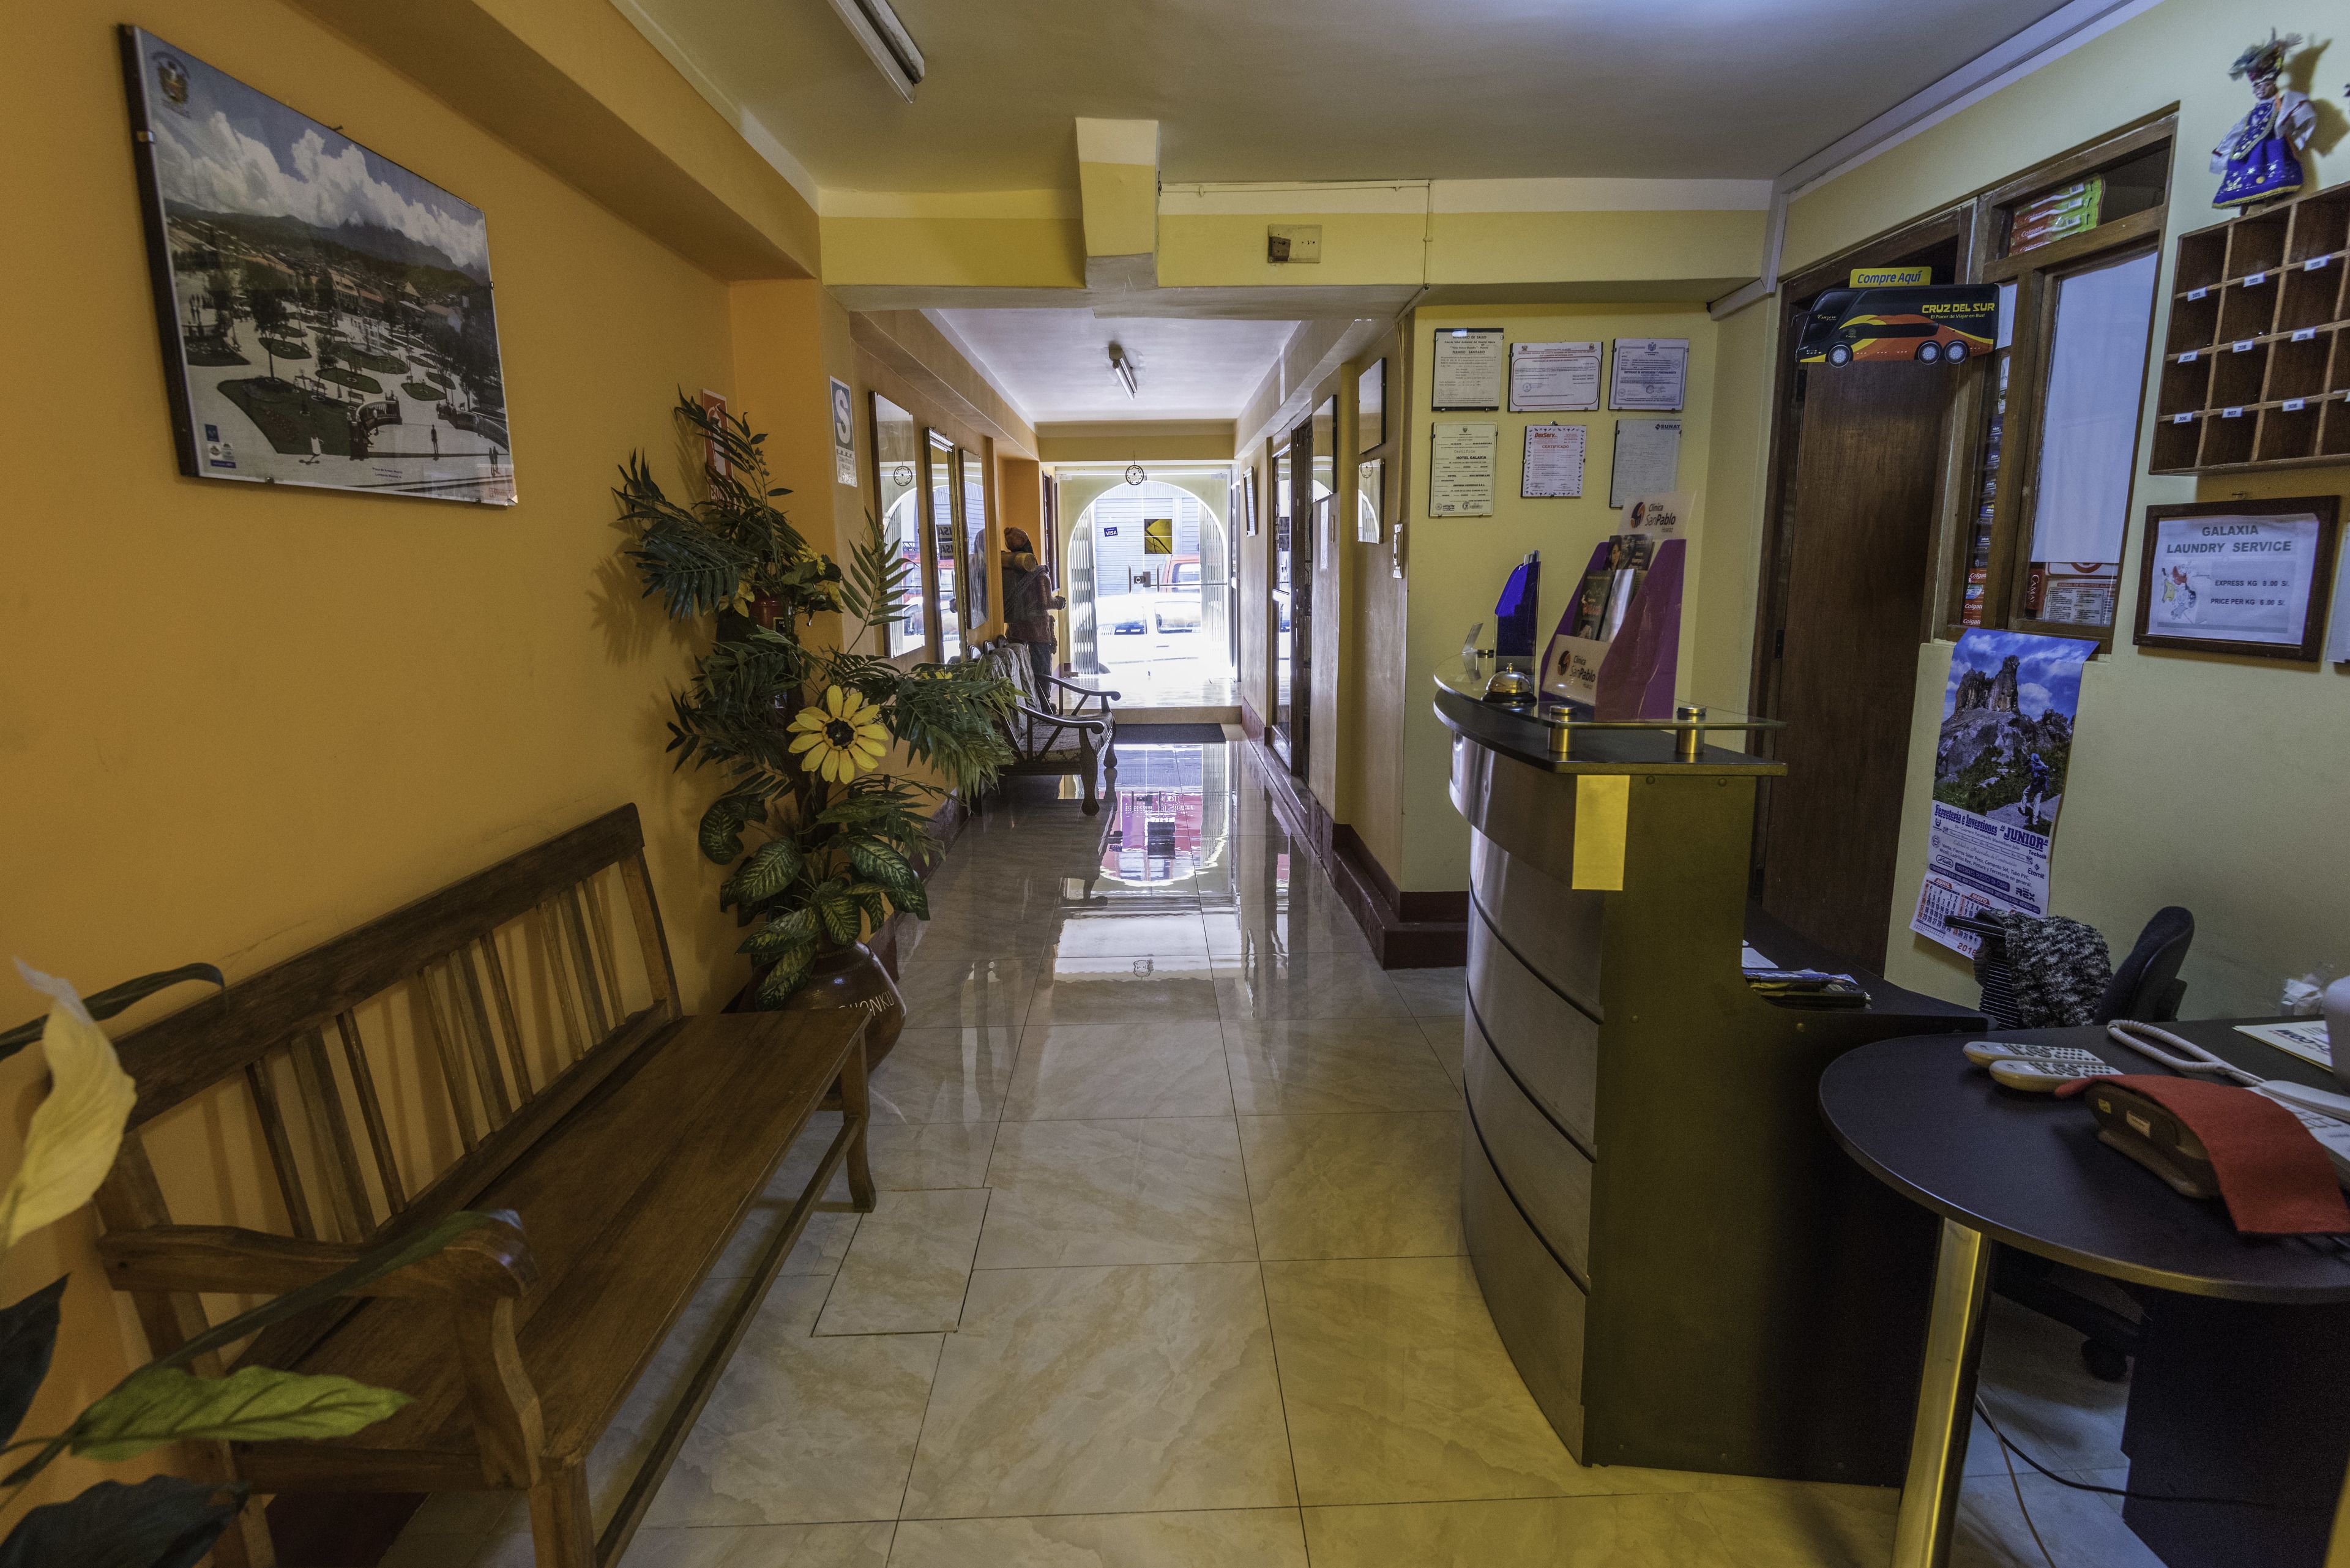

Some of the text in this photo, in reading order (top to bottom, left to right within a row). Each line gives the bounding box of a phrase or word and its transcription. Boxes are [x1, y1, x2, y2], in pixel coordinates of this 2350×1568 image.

[1857, 271, 1923, 285] Compre Aquí
[1922, 304, 1950, 313] CRUZ
[1952, 304, 1971, 312] DEL
[2202, 525, 2259, 536] GALAXIA
[2166, 541, 2292, 553] LAUNDRY SERVICE
[1965, 815, 1997, 835] Inversiones
[1985, 860, 2001, 870] Cemento
[1936, 879, 1950, 887] ABRIL
[1972, 894, 1988, 903] MAYO
